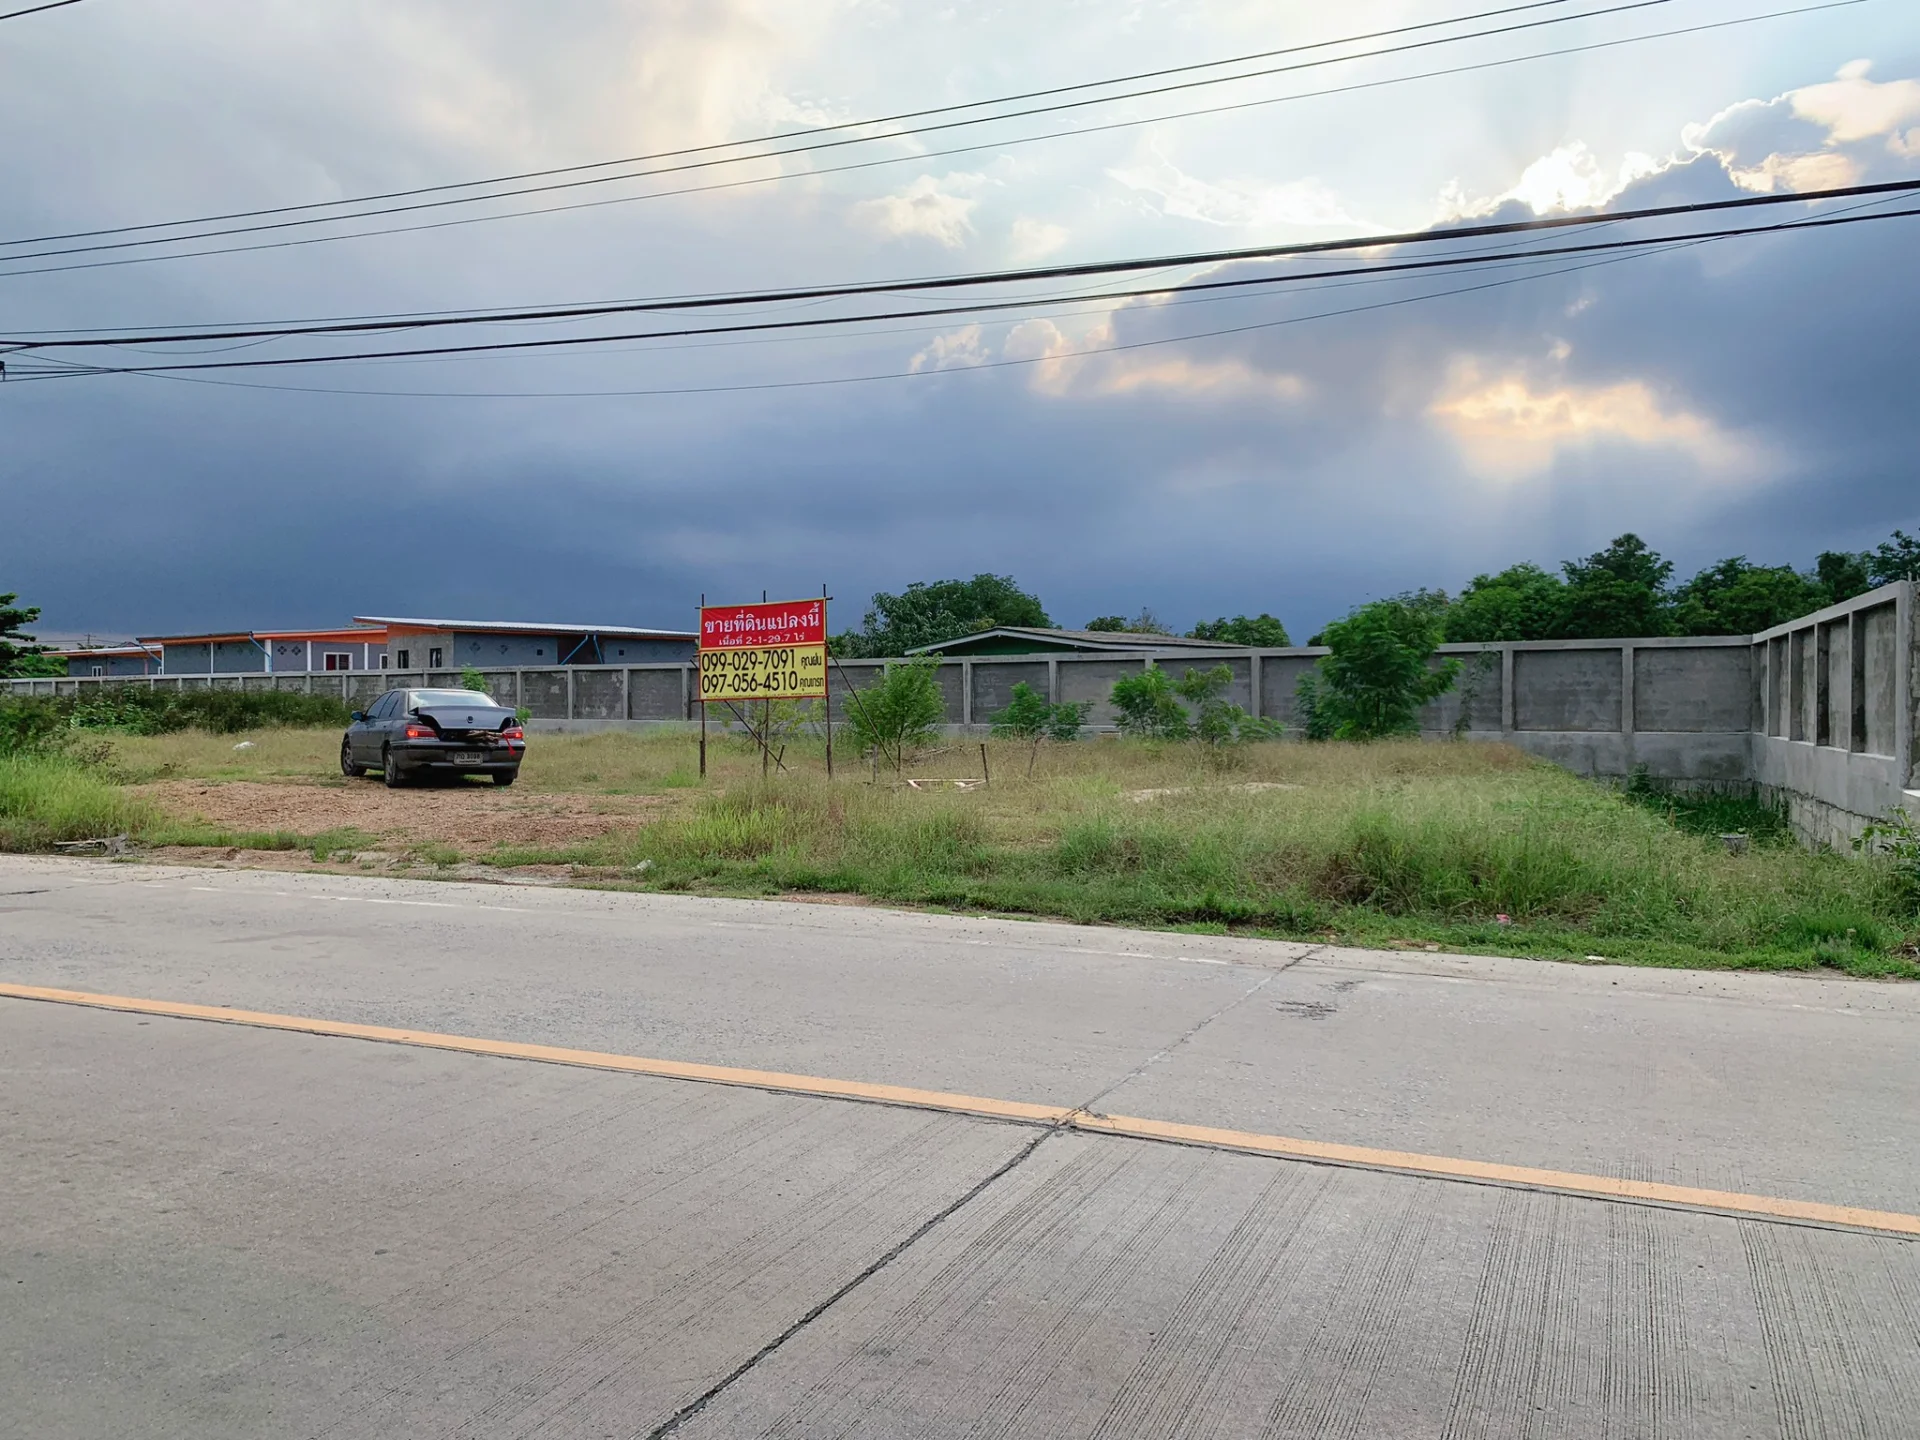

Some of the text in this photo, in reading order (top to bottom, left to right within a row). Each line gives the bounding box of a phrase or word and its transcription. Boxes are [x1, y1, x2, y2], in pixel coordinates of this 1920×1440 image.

[704, 602, 820, 634] ขายที่ดินแปลงนี้
[718, 634, 743, 646] เนื้อที่
[793, 632, 806, 641] ไร่
[702, 649, 795, 672] 099-029-7091
[702, 671, 798, 694] 097-056-4510
